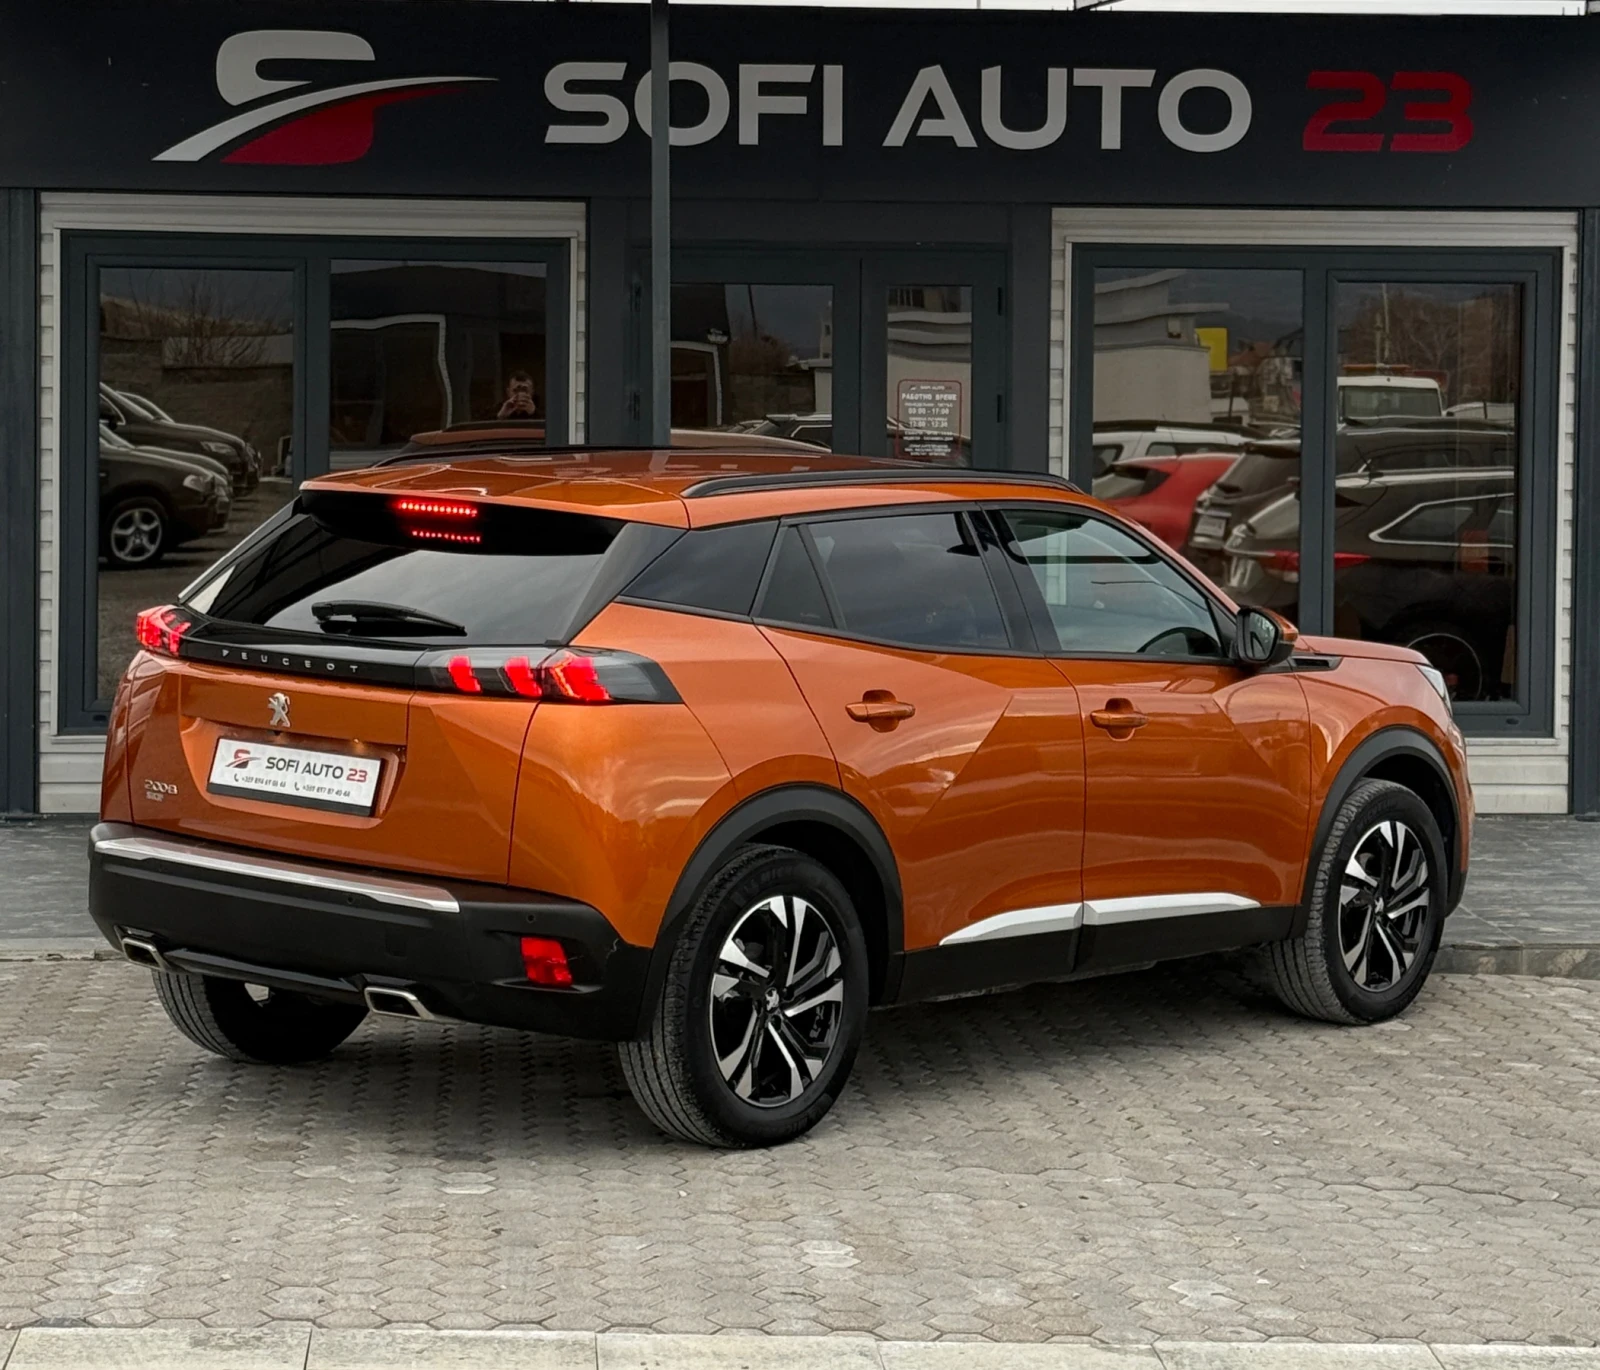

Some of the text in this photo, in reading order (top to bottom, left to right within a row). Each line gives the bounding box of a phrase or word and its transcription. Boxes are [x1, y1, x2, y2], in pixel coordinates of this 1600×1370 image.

[543, 61, 1474, 153] SOFI AUTO 23
[222, 649, 358, 673] PEUGEOT
[265, 756, 368, 783] SOFI AUTO 23
[144, 779, 177, 795] 2008
